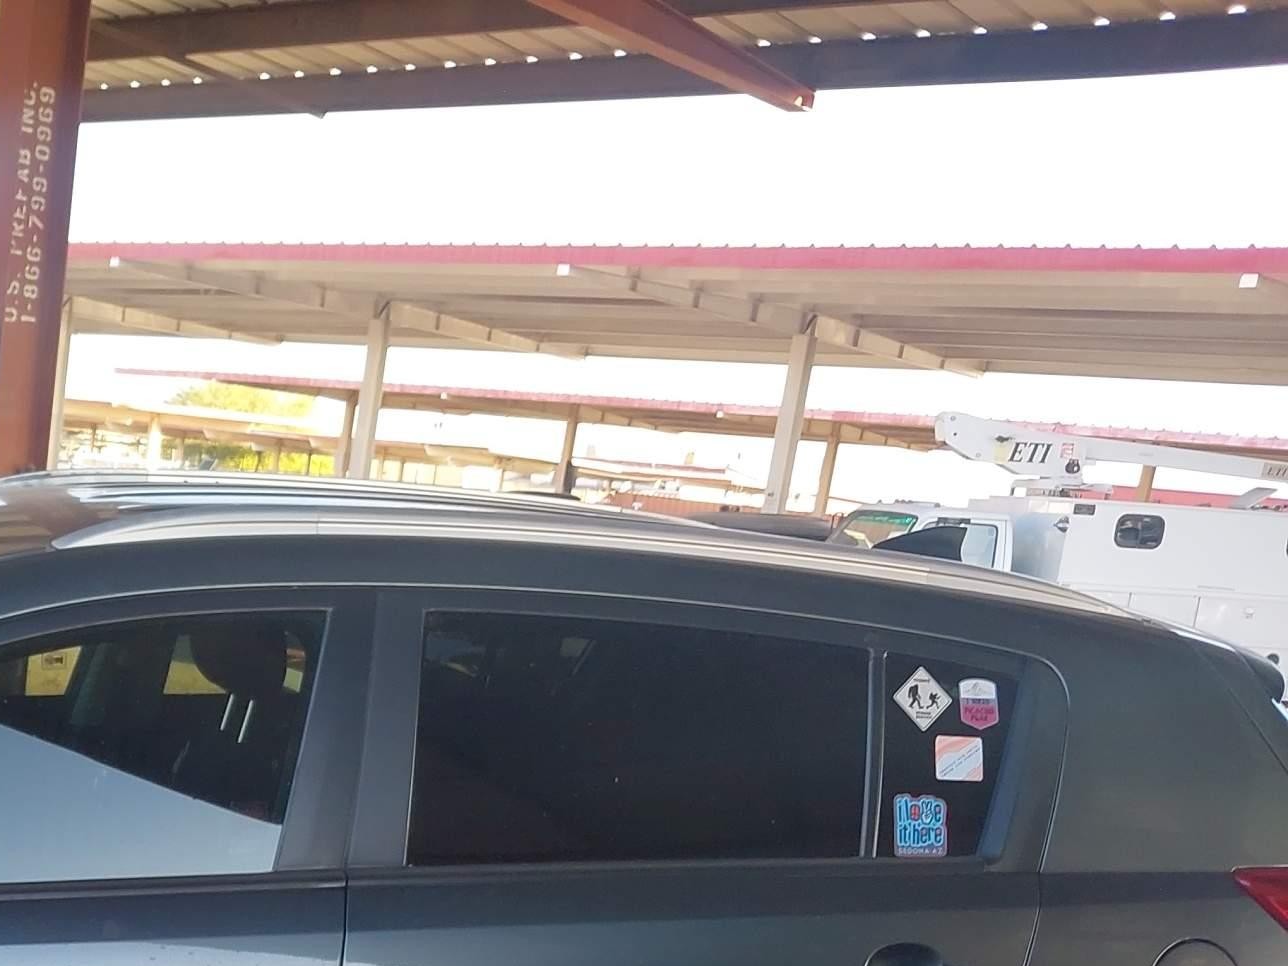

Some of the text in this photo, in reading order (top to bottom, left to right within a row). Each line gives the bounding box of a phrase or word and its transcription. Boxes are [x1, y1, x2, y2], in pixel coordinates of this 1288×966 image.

[20, 86, 56, 323] 1-866-799-0969
[1008, 441, 1053, 465] ETI
[912, 823, 943, 845] here
